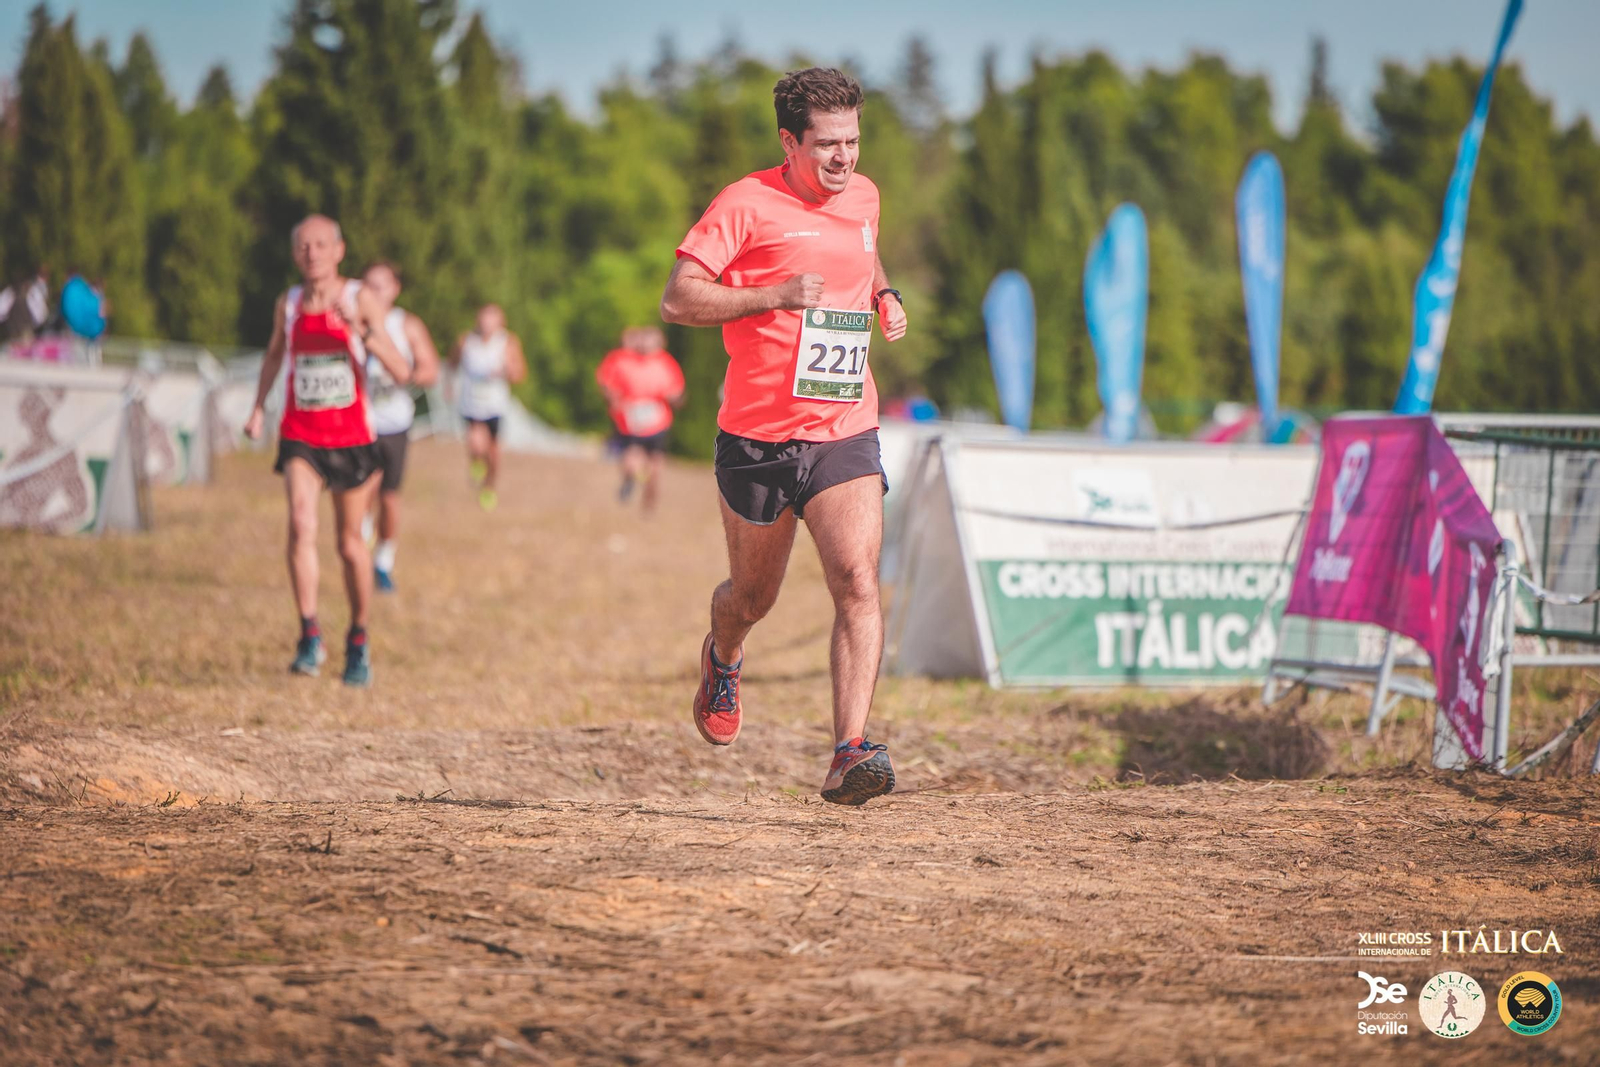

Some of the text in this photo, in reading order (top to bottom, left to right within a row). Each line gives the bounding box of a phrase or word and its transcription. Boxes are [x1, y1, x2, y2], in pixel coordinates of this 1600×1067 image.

[832, 313, 865, 326] ITÁLICA
[807, 343, 867, 375] 2217
[998, 563, 1105, 600] CROSS
[1095, 599, 1277, 669] ITÁLICA
